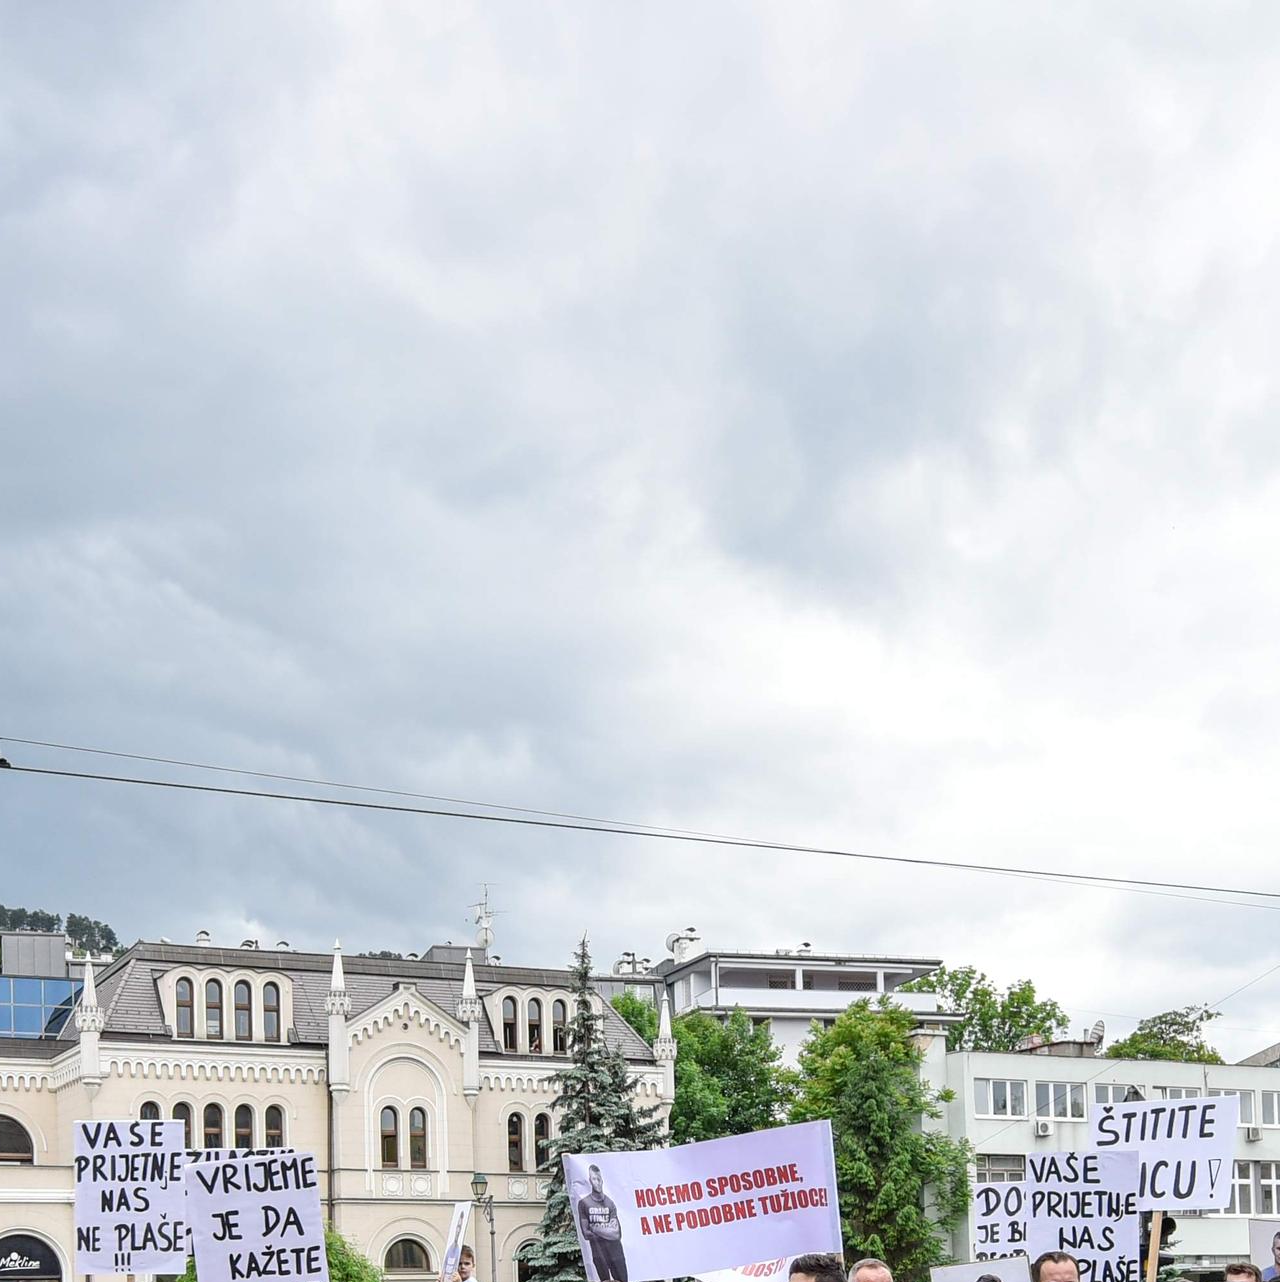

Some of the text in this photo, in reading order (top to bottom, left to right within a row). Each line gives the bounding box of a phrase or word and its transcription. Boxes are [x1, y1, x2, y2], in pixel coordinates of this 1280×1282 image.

[1096, 1106, 1216, 1147] ŠTITITE
[196, 1157, 317, 1195] VRIJEME
[634, 1163, 803, 1208] HOĆEMO SPOSOBNE,
[1029, 1152, 1101, 1184] VAŠE
[101, 1187, 150, 1212] NAS
[640, 1188, 828, 1235] A NE PODOBNE TUŽIOCE!
[77, 1213, 184, 1252] NE PLAŠE
[212, 1206, 304, 1241] JE DA
[977, 1223, 1000, 1244] JE
[1059, 1226, 1115, 1251] NAS
[229, 1245, 321, 1280] KAŽETE
